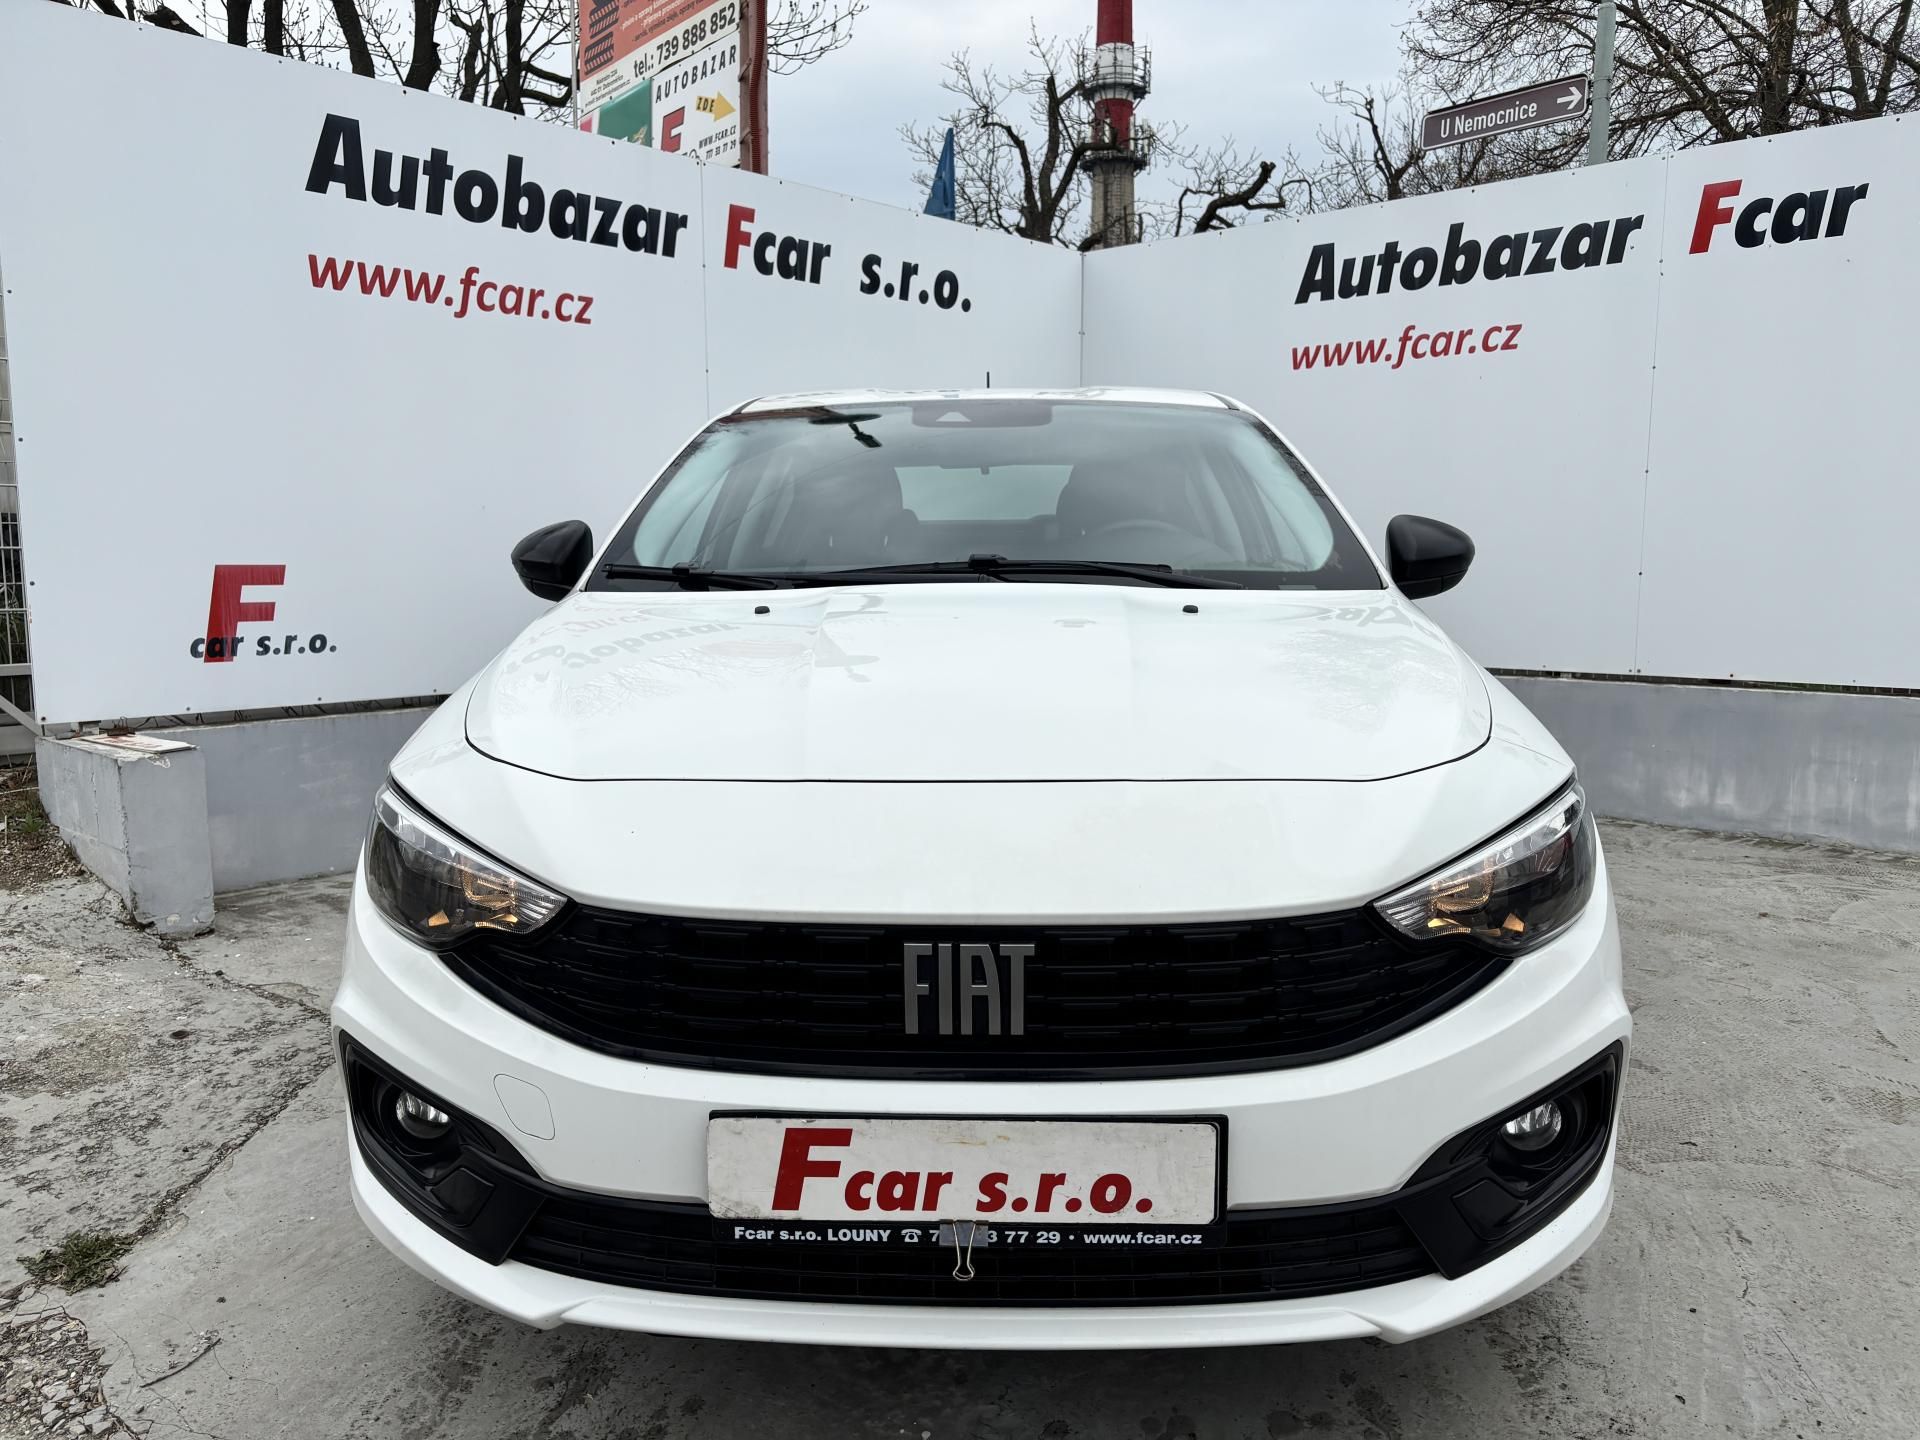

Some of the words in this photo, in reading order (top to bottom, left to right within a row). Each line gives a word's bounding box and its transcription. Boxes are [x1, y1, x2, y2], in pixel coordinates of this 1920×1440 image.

[633, 53, 654, 78] tel.:
[656, 36, 679, 65] 739
[682, 19, 707, 50] 888
[710, 2, 736, 34] 852
[655, 44, 737, 103] AUTOBAZAR
[697, 97, 715, 112] ZDE
[1440, 117, 1450, 138] U
[1454, 102, 1538, 136] Nemocnice
[305, 113, 688, 258] Autobazar
[724, 203, 831, 284] Fcar
[860, 252, 971, 312] s.r.o.
[1294, 214, 1645, 305] Autobazar
[1688, 179, 1870, 255] Fcar
[307, 253, 594, 324] www.fcar.cz
[1290, 323, 1523, 370] www.fcar.cz
[190, 635, 244, 659] car
[256, 633, 337, 656] s.r.o.
[904, 943, 1035, 1035] FIAT
[771, 1127, 953, 1212] Fcar
[975, 1171, 1154, 1213] s.r.o.
[734, 1226, 774, 1240] Fcar
[779, 1229, 822, 1241] s.r.o.
[827, 1229, 891, 1242] LOUNY
[1004, 1231, 1029, 1243] 77
[1036, 1231, 1061, 1243] 29
[1083, 1231, 1202, 1244] www.fcar.cz
